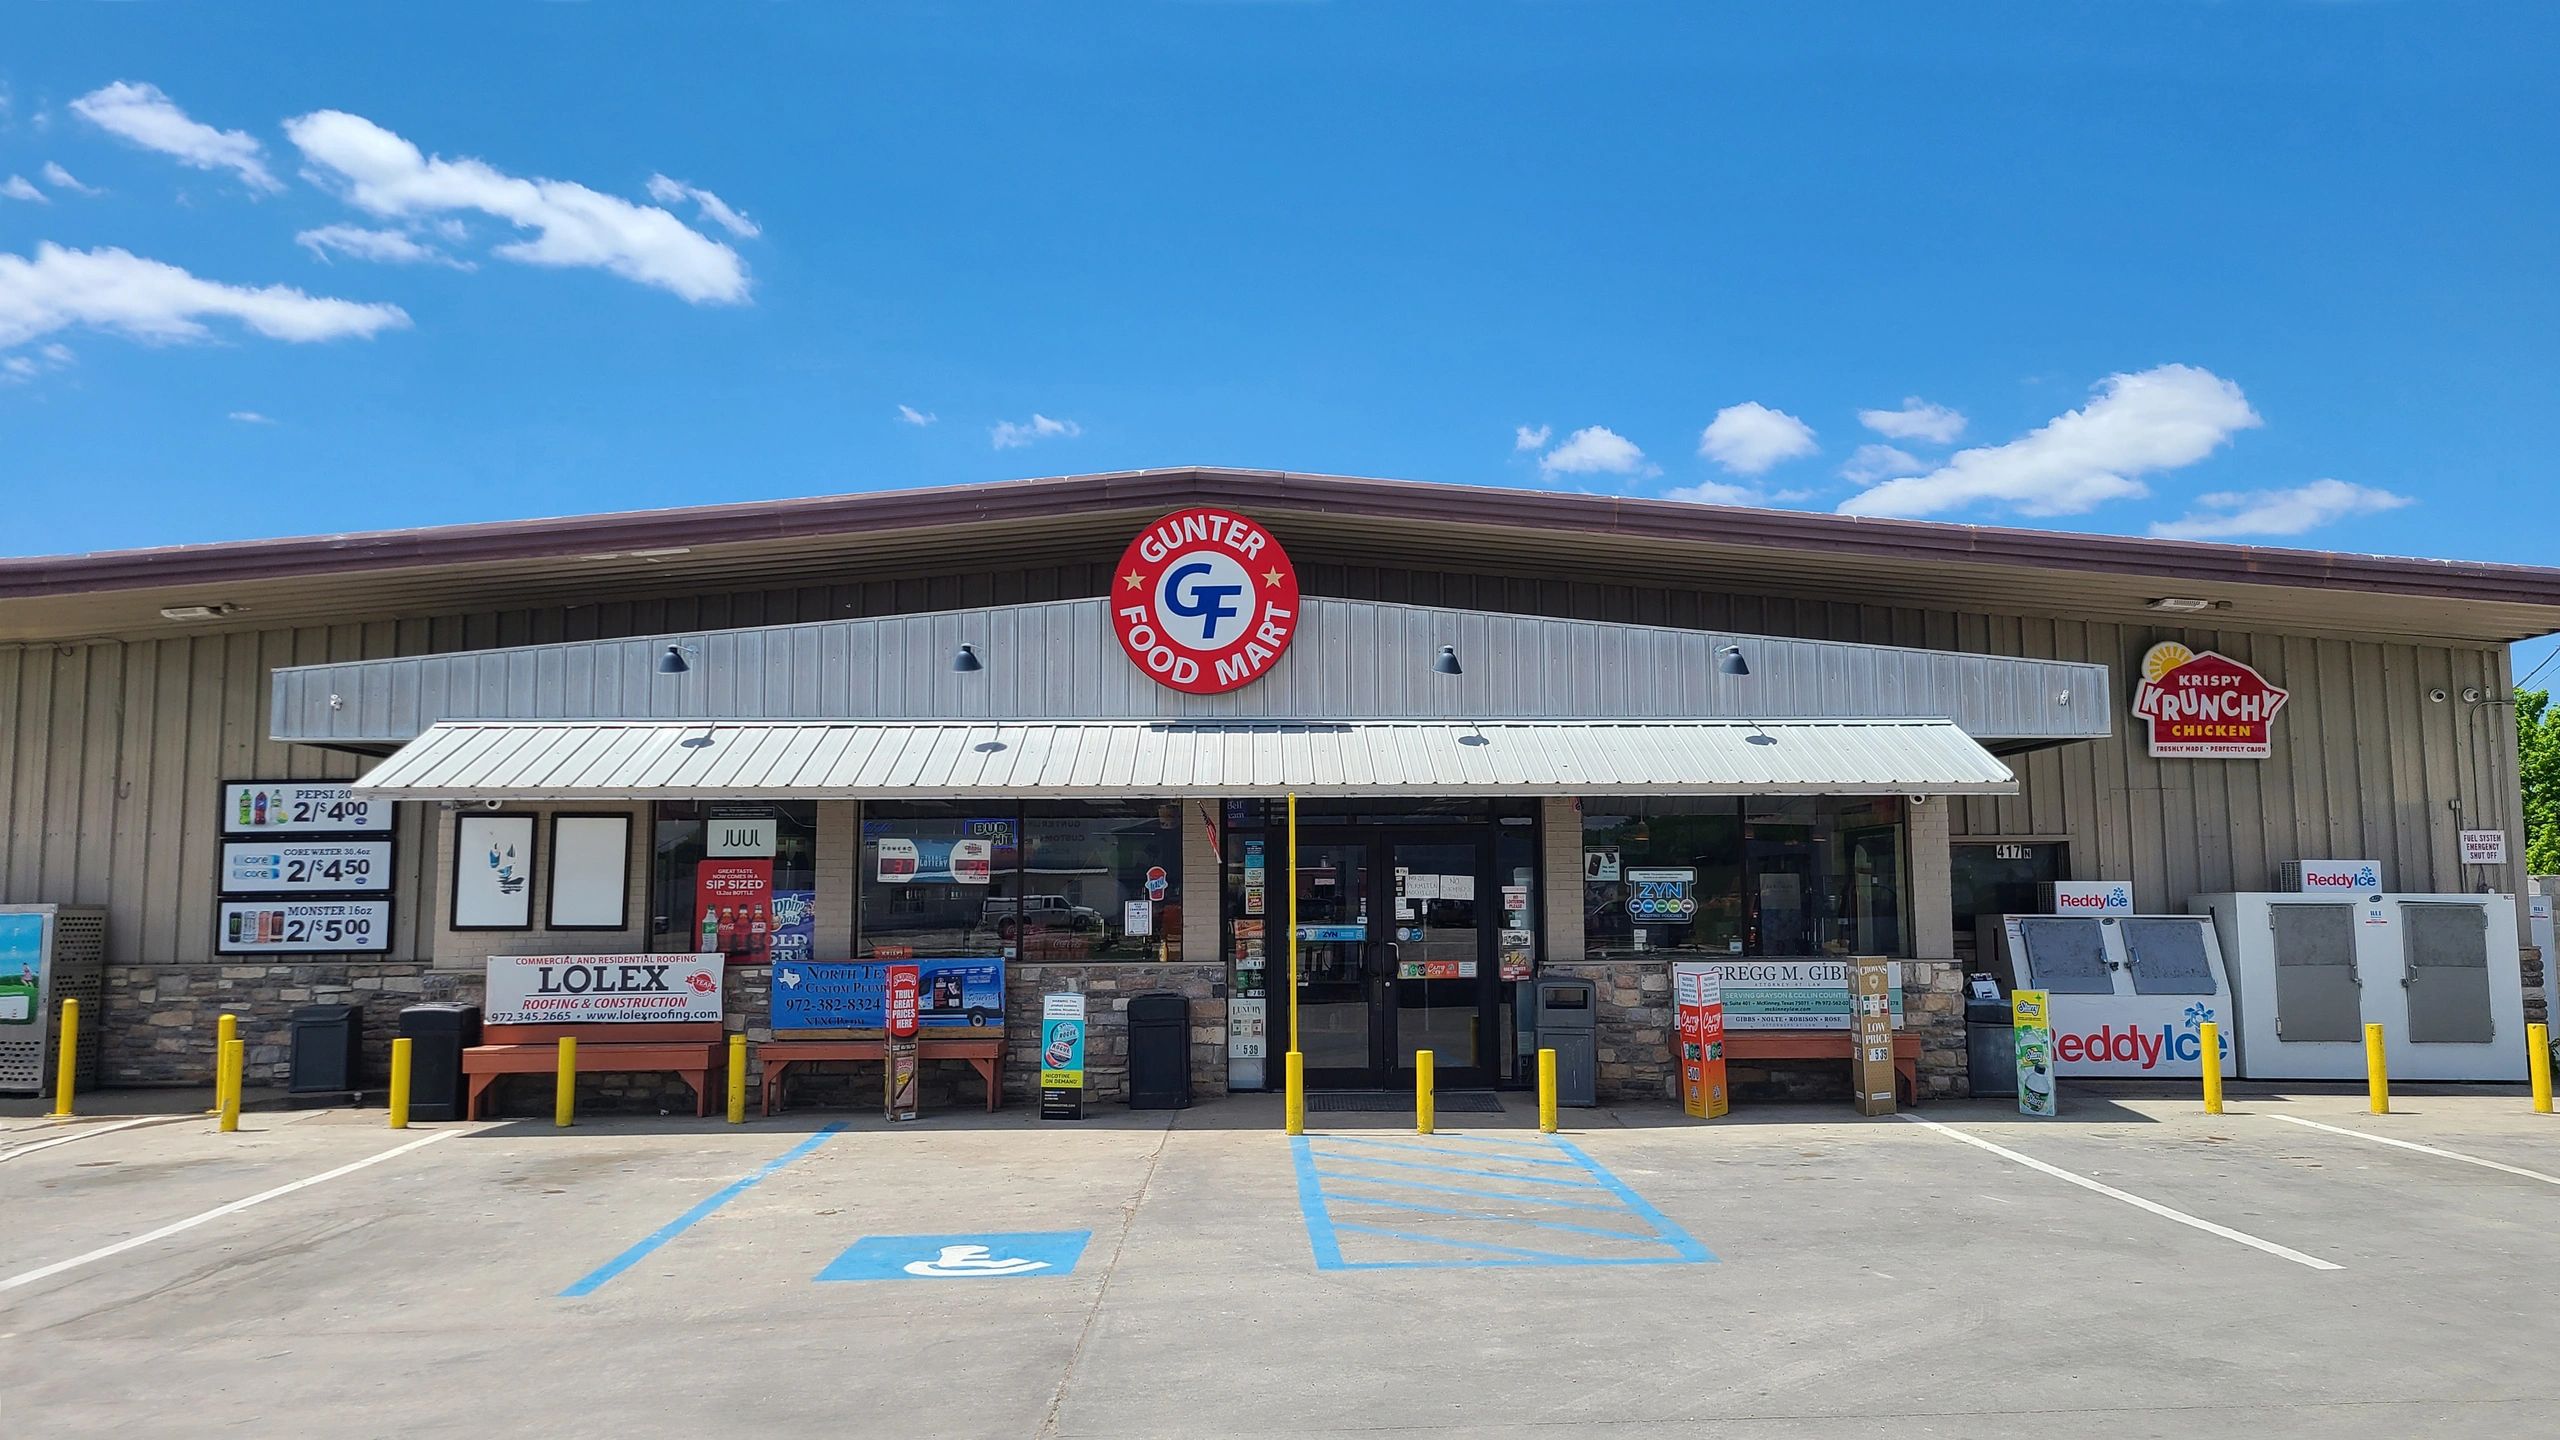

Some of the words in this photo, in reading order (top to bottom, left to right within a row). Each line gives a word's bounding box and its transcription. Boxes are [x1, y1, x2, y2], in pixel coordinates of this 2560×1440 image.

[1140, 515, 1265, 561] GUNTER
[1164, 563, 1242, 639] GF
[1120, 605, 1200, 683] FOOD
[1215, 601, 1291, 686] MART
[2178, 675, 2242, 687] KRISPY
[2141, 685, 2282, 722] KRUNCHY
[2172, 725, 2250, 737] CHICKEN
[295, 790, 335, 799] PEPSI
[974, 822, 1008, 834] BUD
[723, 829, 761, 847] JUUL
[2463, 834, 2478, 842] FUEL
[2479, 834, 2501, 842] SYSTEM
[1997, 845, 2021, 858] 417
[2024, 849, 2031, 858] N
[2466, 843, 2499, 851] EMERGENCY
[2470, 852, 2485, 860] SHUT
[2486, 852, 2497, 860] OFF
[706, 880, 726, 889] SIP
[728, 880, 764, 889] SIZED
[2307, 873, 2376, 889] ReddyIce
[1639, 882, 1683, 898] ZYN
[2060, 894, 2128, 909] ReddyIce
[287, 906, 346, 916] MONSTER
[348, 906, 372, 915] 16oz
[516, 957, 574, 965] COMMERCIAL
[576, 956, 596, 964] AND
[598, 955, 654, 964] RESIDENTIAL
[656, 955, 697, 963] ROOFING
[807, 966, 856, 980] NORTH
[1711, 966, 1776, 981] GREGG
[1782, 966, 1803, 980] M.
[1809, 965, 1847, 980] GIB
[1860, 965, 1887, 976] CROWNS
[538, 965, 670, 993] LOLEX
[895, 989, 914, 999] TRULY
[522, 999, 579, 1010] ROOFING
[581, 998, 592, 1009] &
[594, 997, 688, 1009] CONSTRUCTION
[786, 998, 881, 1011] 972-382-8324
[893, 999, 914, 1009] GREAT
[491, 1011, 571, 1022] 972.345.2665
[586, 1009, 718, 1021] www.lolexroofing.com
[892, 1009, 916, 1019] PRICES
[1232, 1006, 1262, 1015] LUXURY
[896, 1019, 913, 1029] HERE
[1868, 1022, 1885, 1033] LOW
[1865, 1033, 1890, 1045] PRICE
